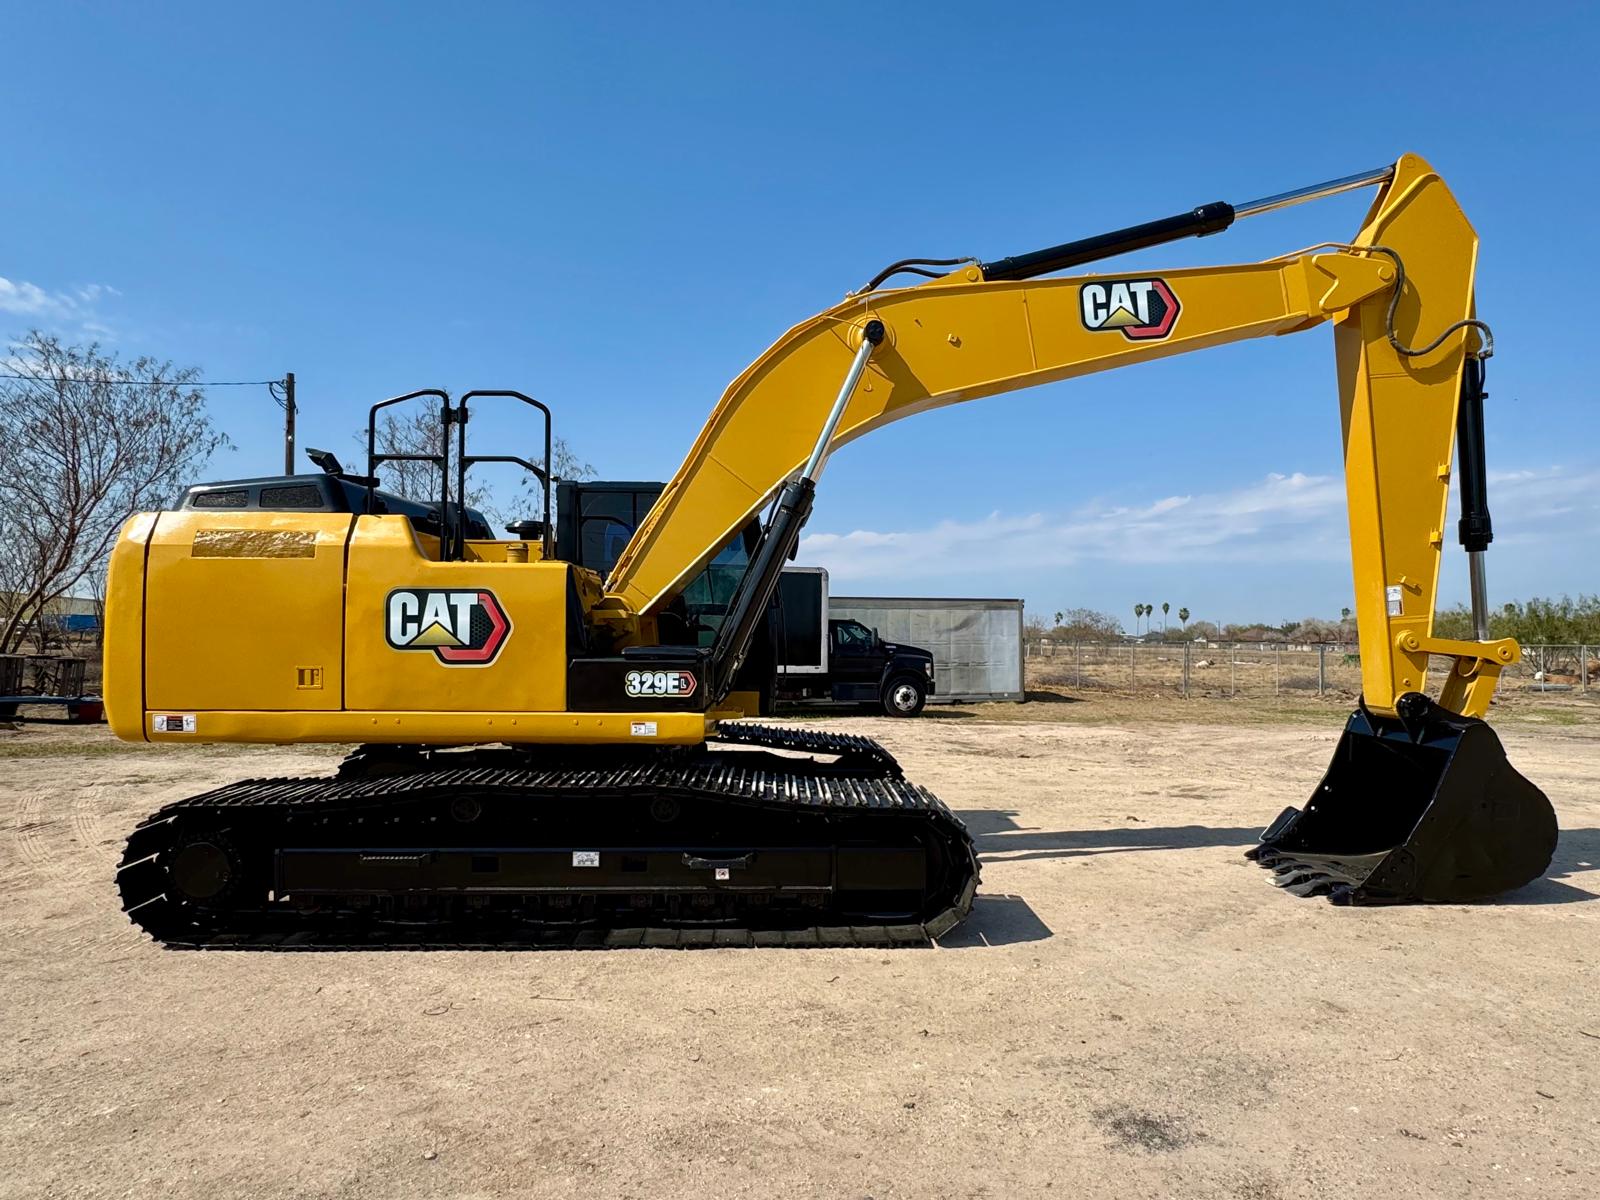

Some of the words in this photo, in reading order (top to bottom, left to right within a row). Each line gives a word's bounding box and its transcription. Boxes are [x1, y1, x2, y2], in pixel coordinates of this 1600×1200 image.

[1083, 282, 1153, 328] CAT
[389, 591, 479, 646] CAT
[628, 672, 680, 694] 329E
